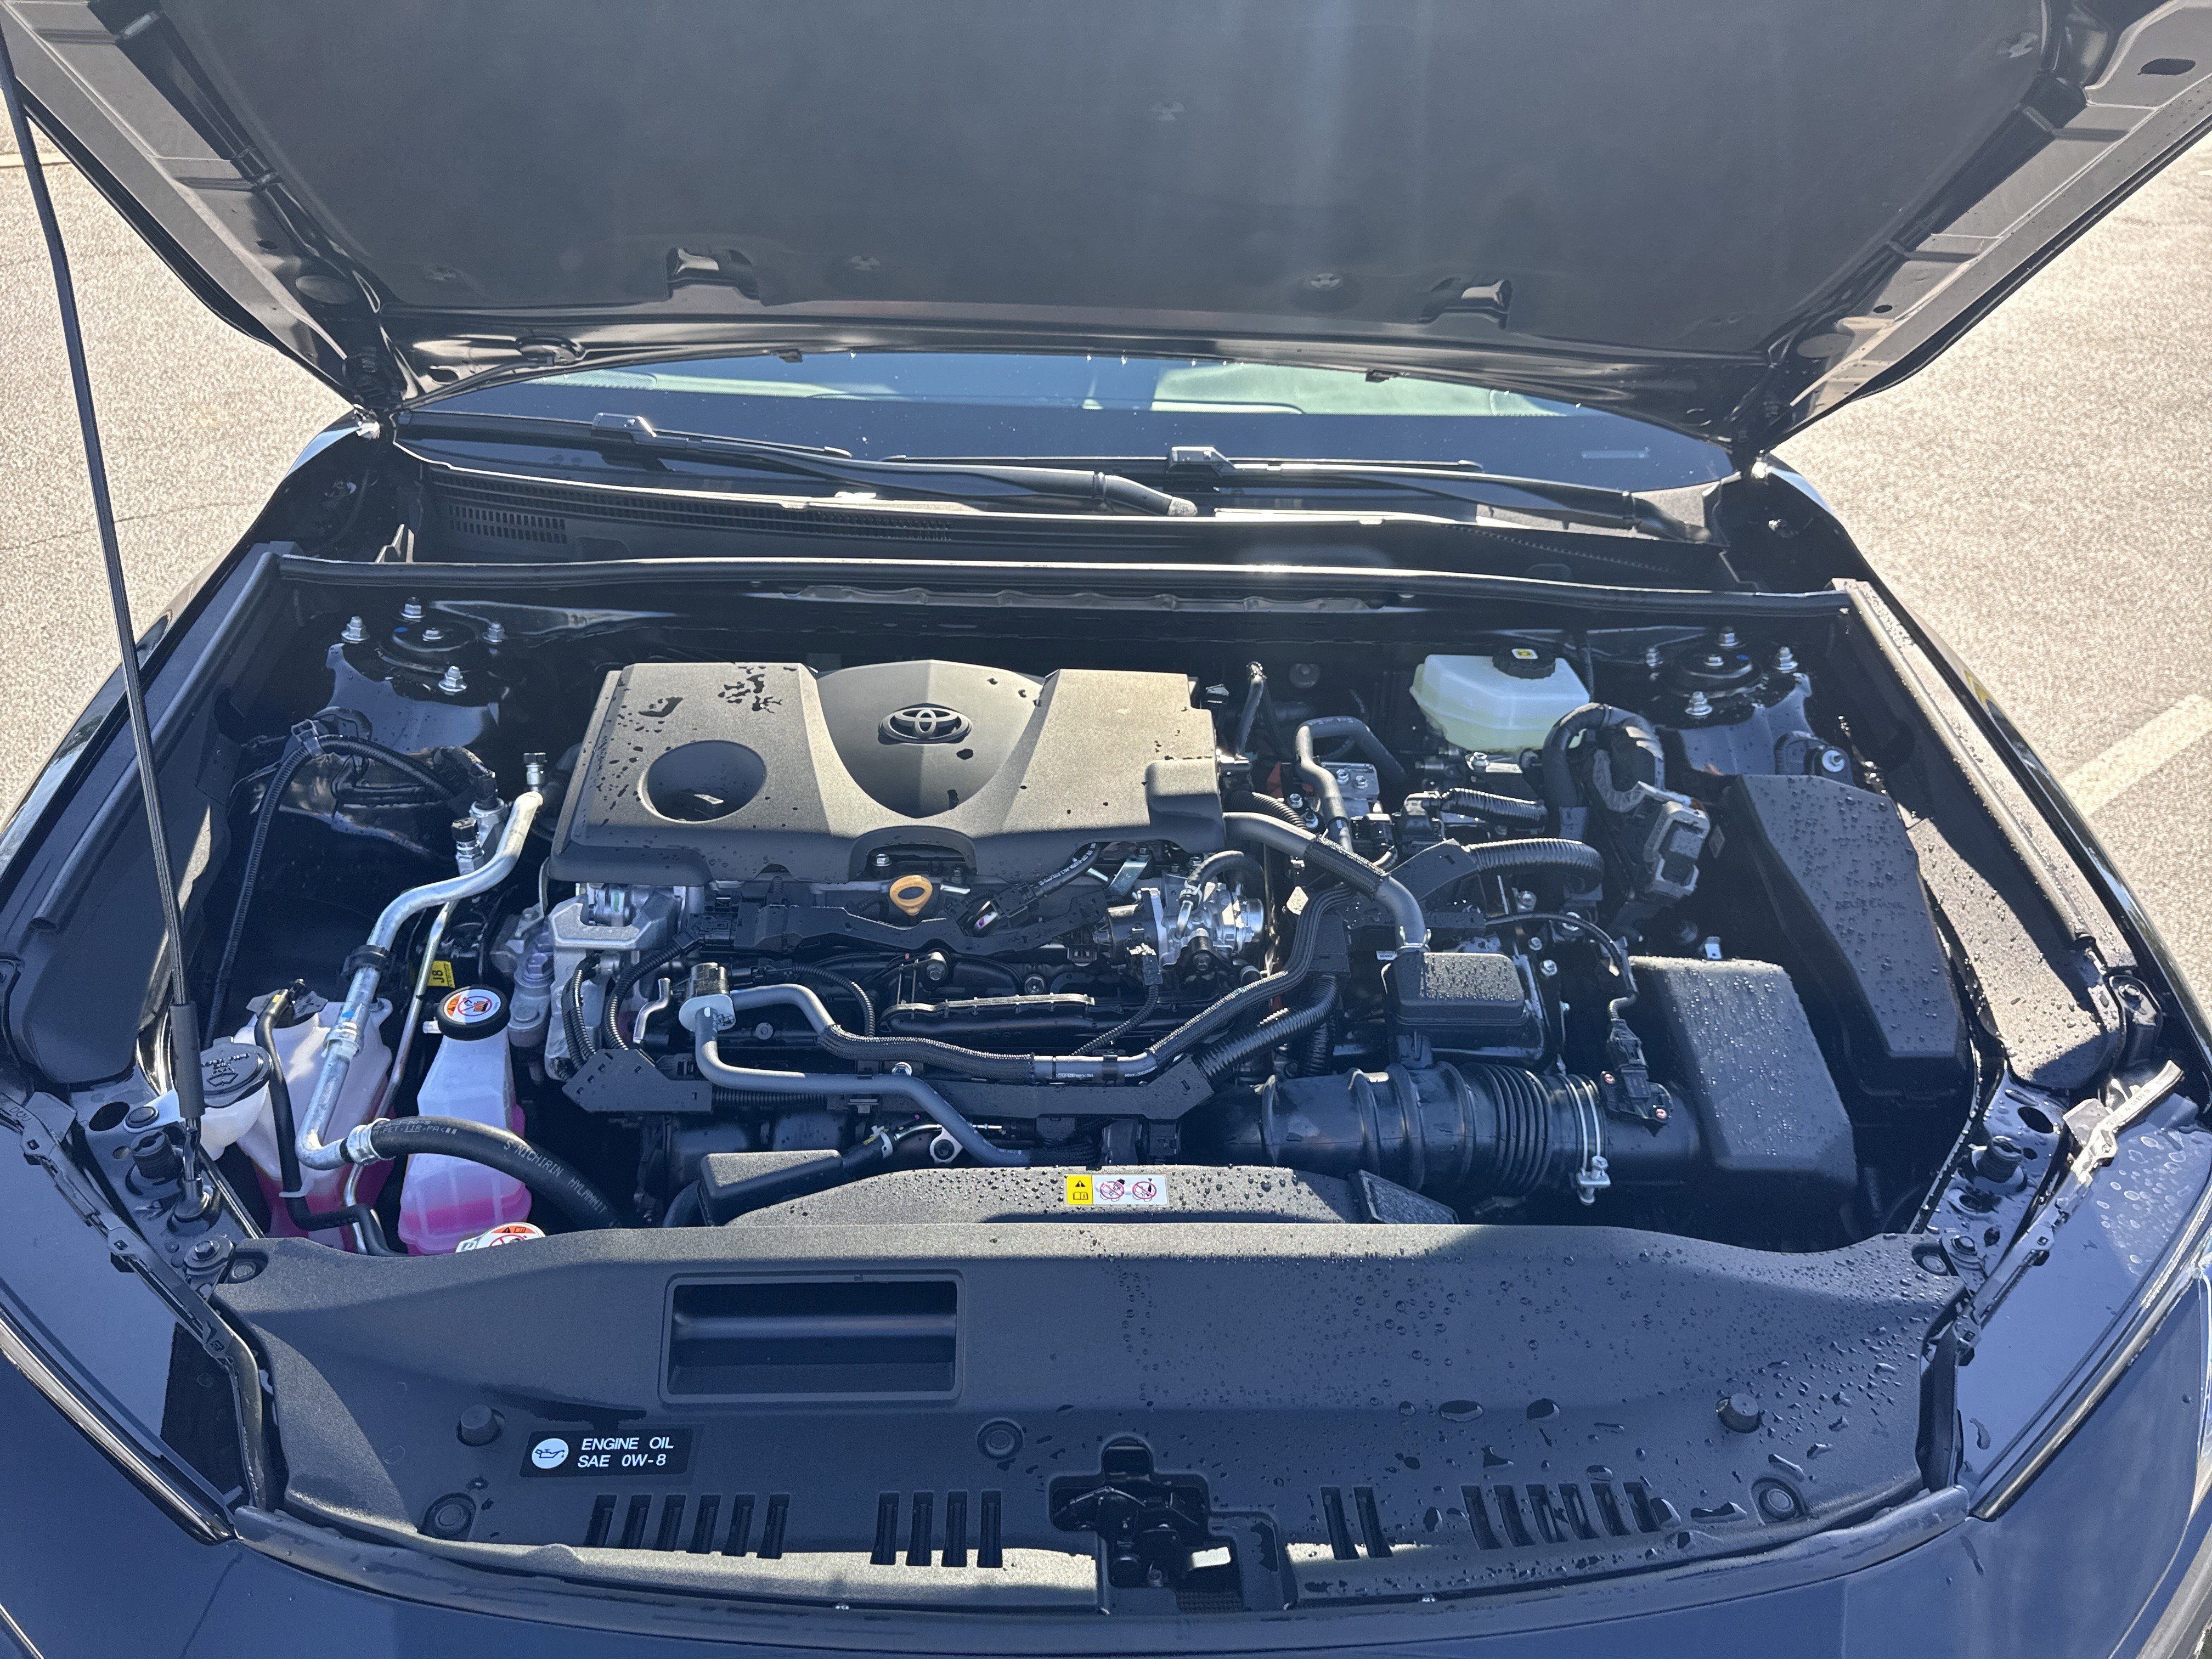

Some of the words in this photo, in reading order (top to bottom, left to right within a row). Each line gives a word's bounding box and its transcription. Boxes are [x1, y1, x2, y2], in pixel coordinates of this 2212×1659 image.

[581, 1437, 640, 1451] ENGINE
[649, 1436, 674, 1449] OIL
[577, 1454, 611, 1468] SAE
[622, 1453, 667, 1467] 0W-8
